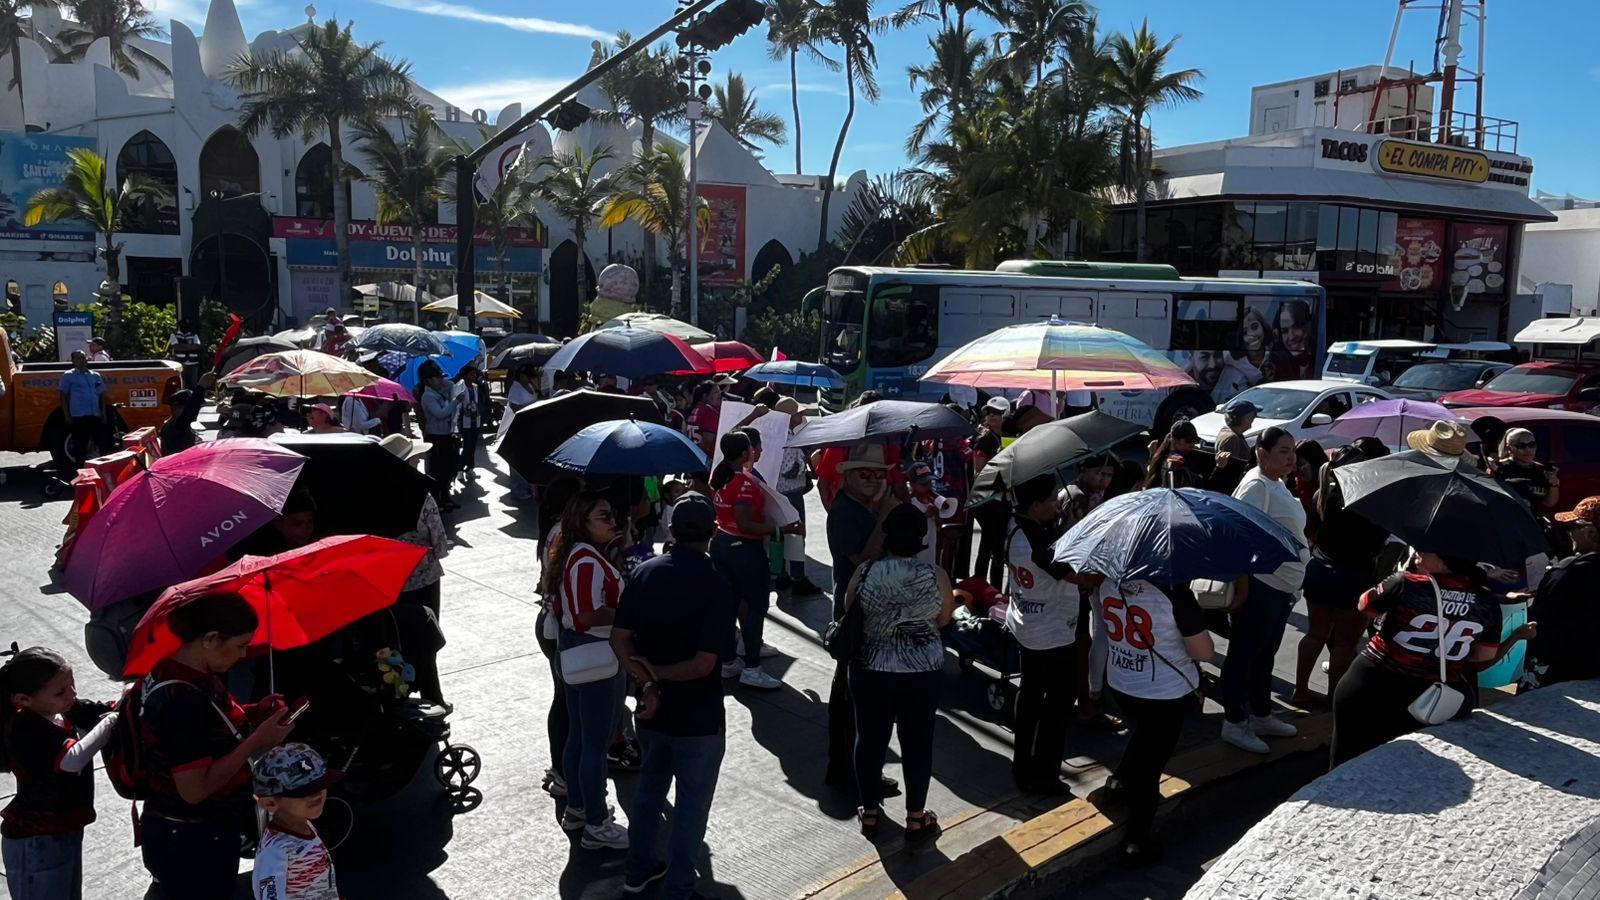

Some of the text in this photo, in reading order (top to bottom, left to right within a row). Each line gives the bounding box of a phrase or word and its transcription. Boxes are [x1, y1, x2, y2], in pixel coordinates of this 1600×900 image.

[1320, 138, 1368, 163] TACOS
[1390, 147, 1479, 177] EL COMPA PITY
[428, 227, 449, 238] DE
[200, 510, 248, 547] AVON
[1442, 600, 1469, 616] TOTO
[1465, 592, 1477, 603] DE
[1102, 597, 1155, 650] 58
[1393, 613, 1484, 661] 26
